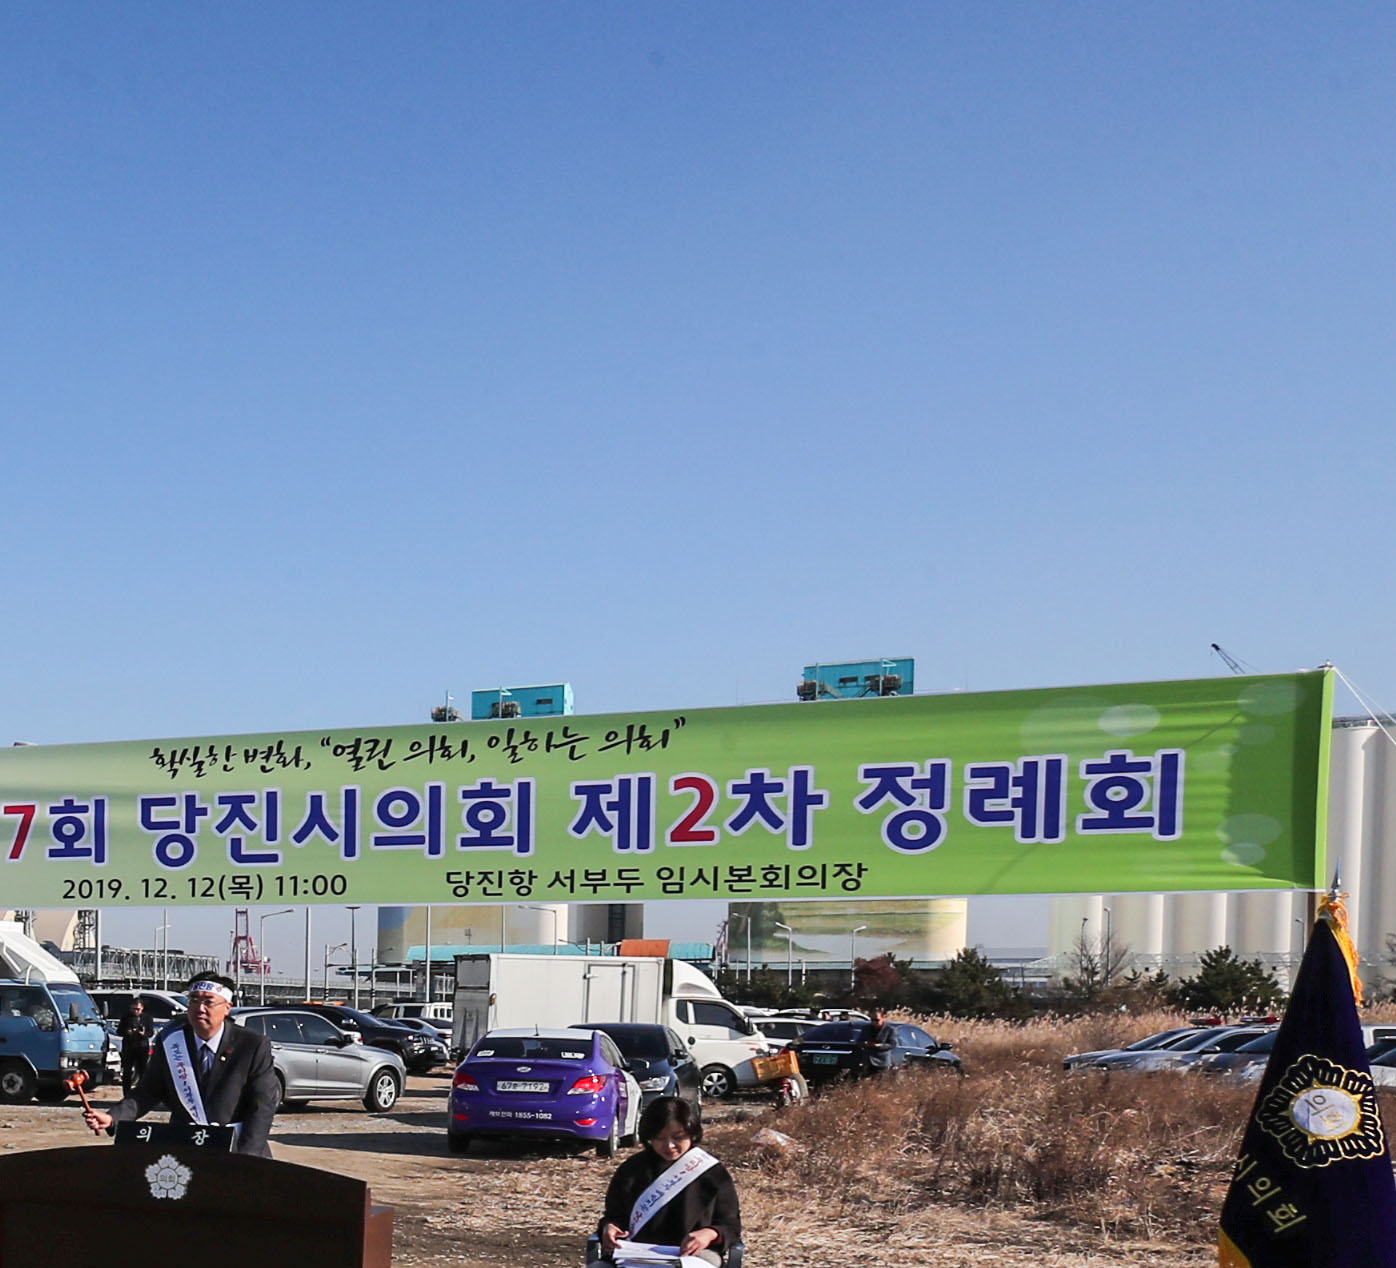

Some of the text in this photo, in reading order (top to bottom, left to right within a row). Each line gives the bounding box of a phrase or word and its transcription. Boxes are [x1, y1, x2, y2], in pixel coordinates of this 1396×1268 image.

[150, 746, 235, 779] 확실한
[244, 740, 312, 773] 변화,
[403, 735, 476, 764] 의회,
[487, 726, 589, 764] 일하는
[140, 777, 535, 869] 당진시의회
[571, 769, 825, 853] 제2차
[859, 751, 1181, 852] 정례회
[63, 872, 348, 901] 2019. 12. 12(목) 11:00
[446, 861, 869, 898] 당진항 서부두 임시본회의장
[136, 1126, 209, 1145] 의장
